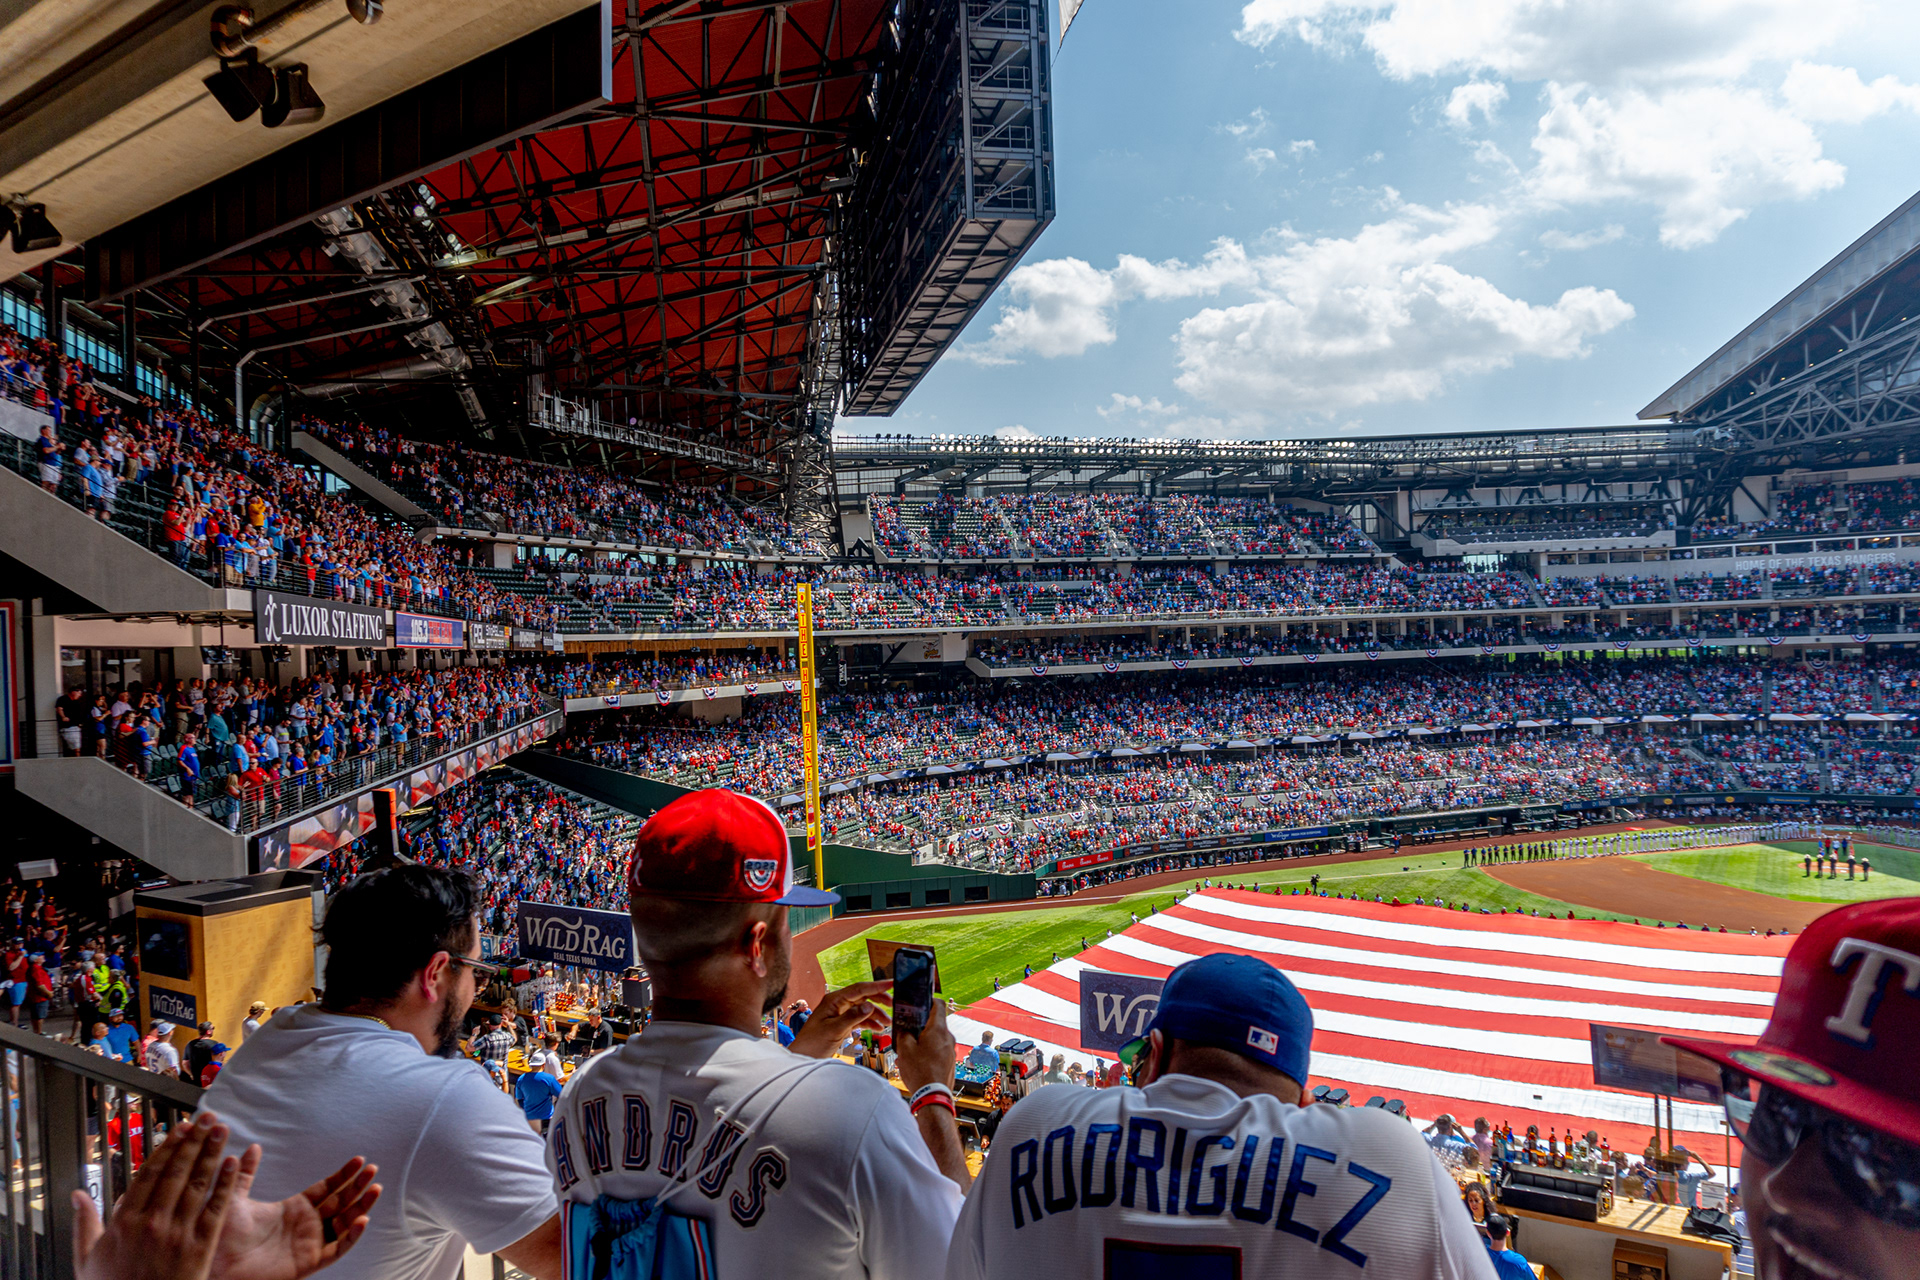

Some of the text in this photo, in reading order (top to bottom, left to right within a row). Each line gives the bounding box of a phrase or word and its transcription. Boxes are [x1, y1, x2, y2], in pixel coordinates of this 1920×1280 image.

[1735, 552, 1896, 571] HOME OF THE TEXAS RANGERS
[281, 603, 383, 640] LUXOR STAFFING
[411, 618, 428, 643] 105.3
[745, 861, 775, 870] 2022
[524, 916, 625, 959] WILD RAG
[553, 952, 597, 966] REAL TEXAS VODKA
[152, 994, 194, 1020] WILD RAG
[551, 1094, 790, 1230] ANDRUS
[1010, 1116, 1393, 1268] RODRIGUEZ
